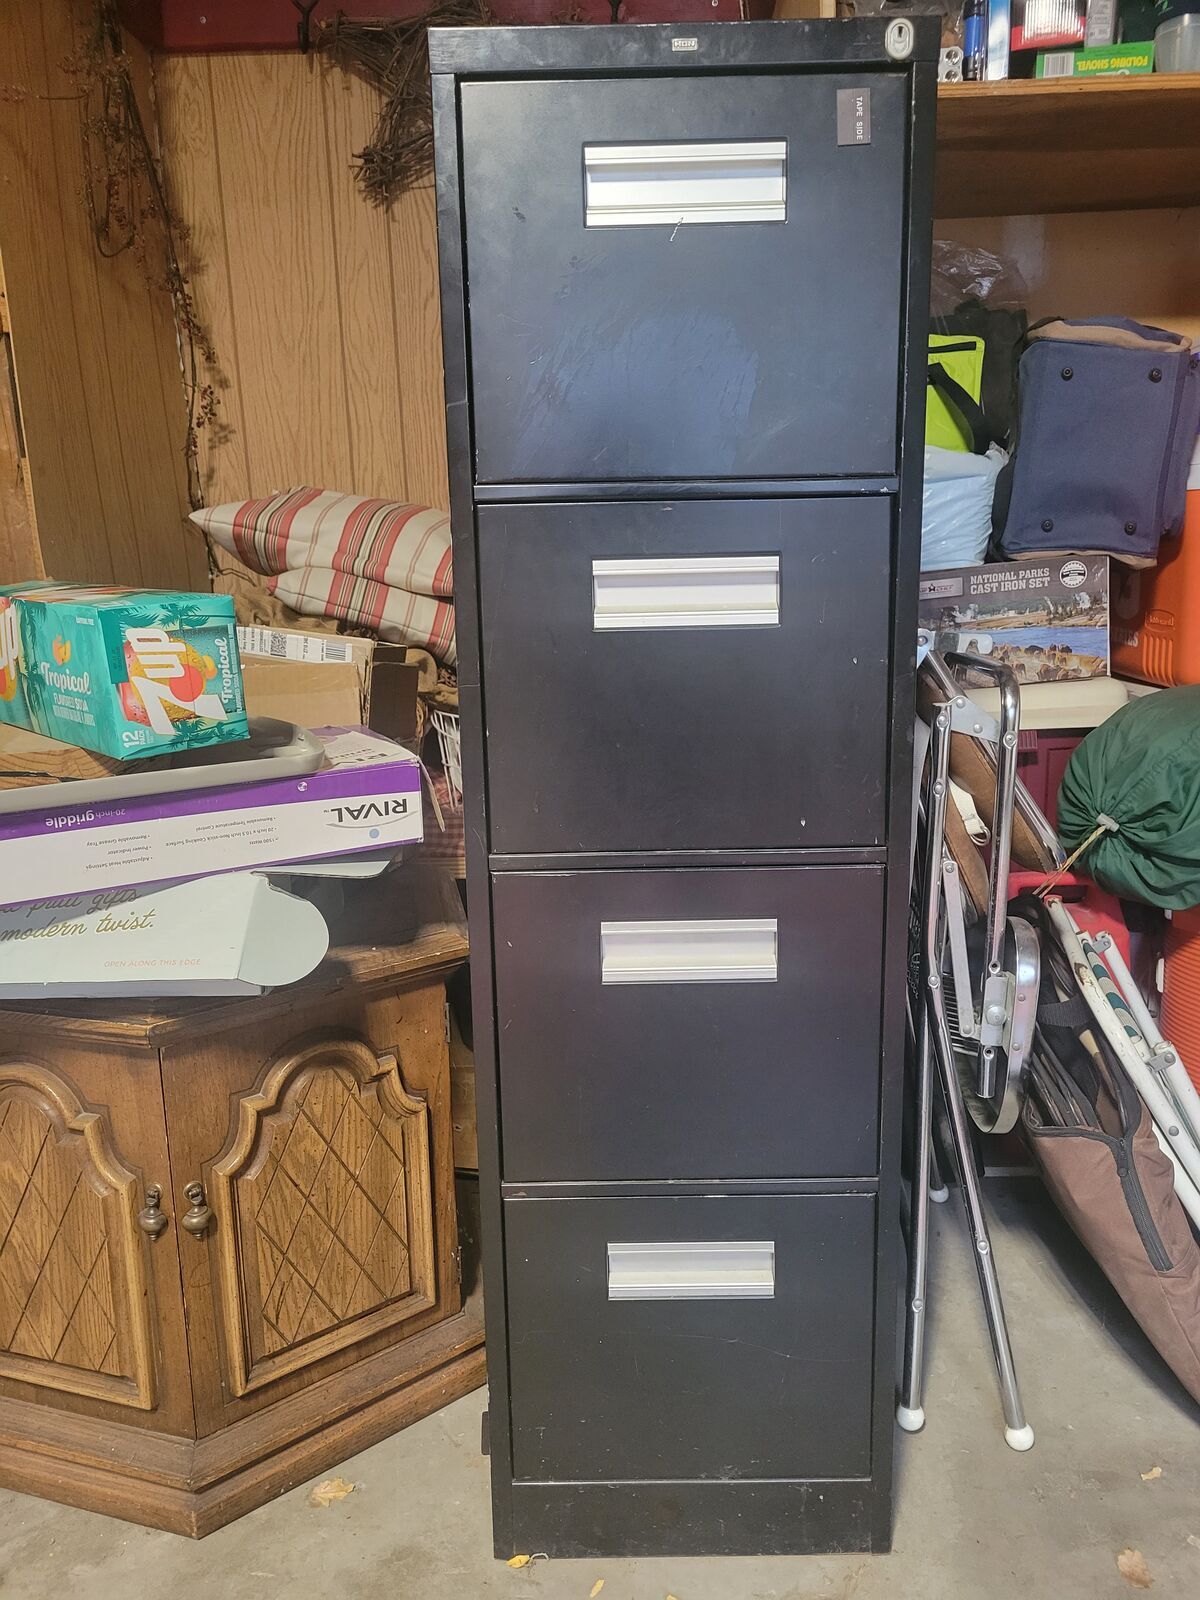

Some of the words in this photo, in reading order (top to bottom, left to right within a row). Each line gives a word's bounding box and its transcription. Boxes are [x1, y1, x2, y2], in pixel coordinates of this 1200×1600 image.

[1077, 59, 1109, 72] SHOVEL
[1111, 55, 1149, 68] FOLDING
[970, 571, 1017, 585] NATIONAL
[1019, 567, 1050, 579] PARKS
[970, 582, 998, 595] CAST
[1000, 580, 1026, 592] IRON
[1028, 577, 1051, 588] SET
[40, 661, 92, 695] Tropical
[214, 636, 236, 704] Tropical
[122, 730, 140, 748] 12
[45, 809, 95, 829] griddle
[95, 808, 126, 819] 20-inch
[330, 798, 408, 823] RIVAL
[0, 915, 88, 942] modern
[95, 907, 157, 934] twist.
[103, 960, 126, 968] OPEN
[127, 959, 157, 967] ALONG
[159, 958, 177, 967] THIS
[179, 958, 201, 966] EDGE
